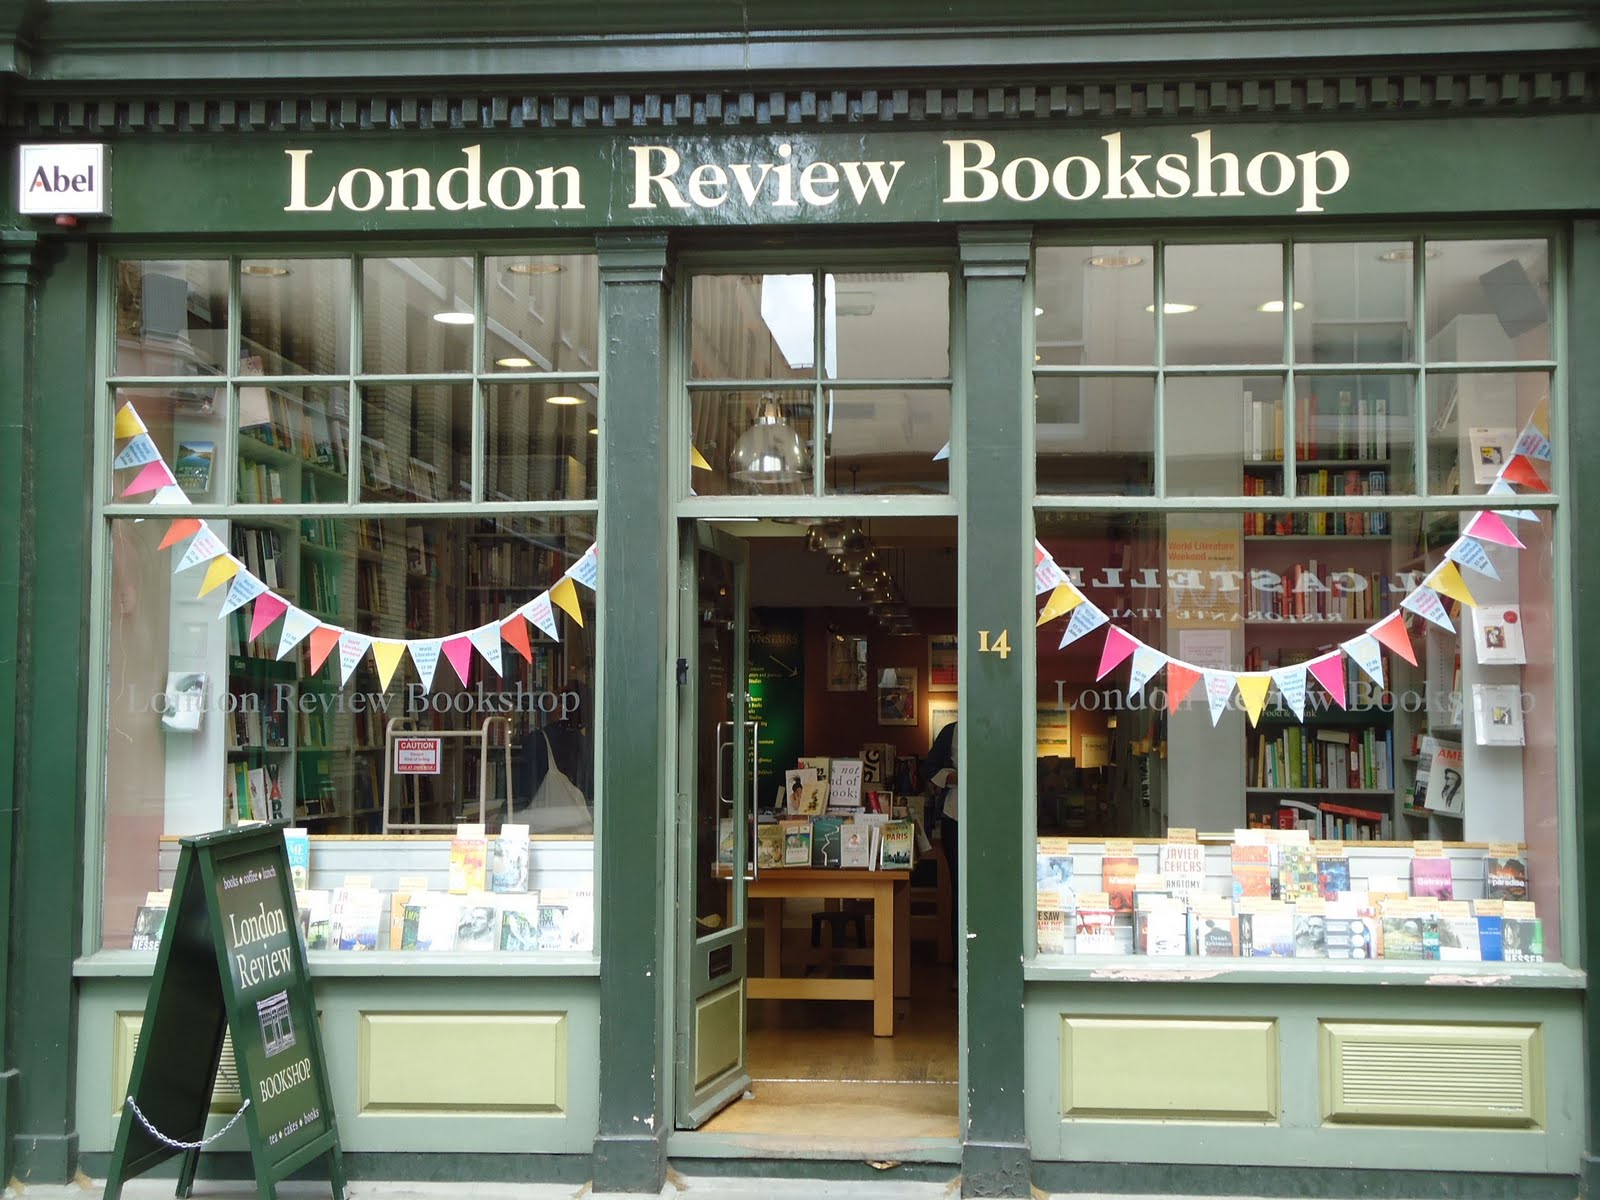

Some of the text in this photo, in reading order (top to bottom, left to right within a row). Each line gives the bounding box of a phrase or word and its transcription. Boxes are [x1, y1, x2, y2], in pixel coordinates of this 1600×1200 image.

[284, 129, 1350, 213] London Review Bookshop
[29, 165, 94, 193] Abel
[1168, 541, 1235, 551] World Literature
[1168, 552, 1207, 562] Weekend
[977, 628, 1012, 660] 14
[128, 681, 580, 722] London Review Bookshop
[1054, 680, 1192, 712] London
[401, 741, 434, 749] CAUTION
[841, 766, 860, 775] not
[846, 776, 860, 786] of
[886, 833, 908, 841] PARIS
[1166, 848, 1199, 860] JAVIER
[1164, 860, 1202, 873] CERCAS
[222, 864, 277, 890] books coffee lunch
[1417, 877, 1451, 887] Betrayal
[1166, 880, 1201, 889] ANATOMY
[1044, 911, 1060, 921] SAW
[229, 901, 287, 949] London
[236, 942, 292, 990] Review
[259, 1057, 312, 1103] BOOKSHOP
[268, 1106, 320, 1146] tea cakes books
